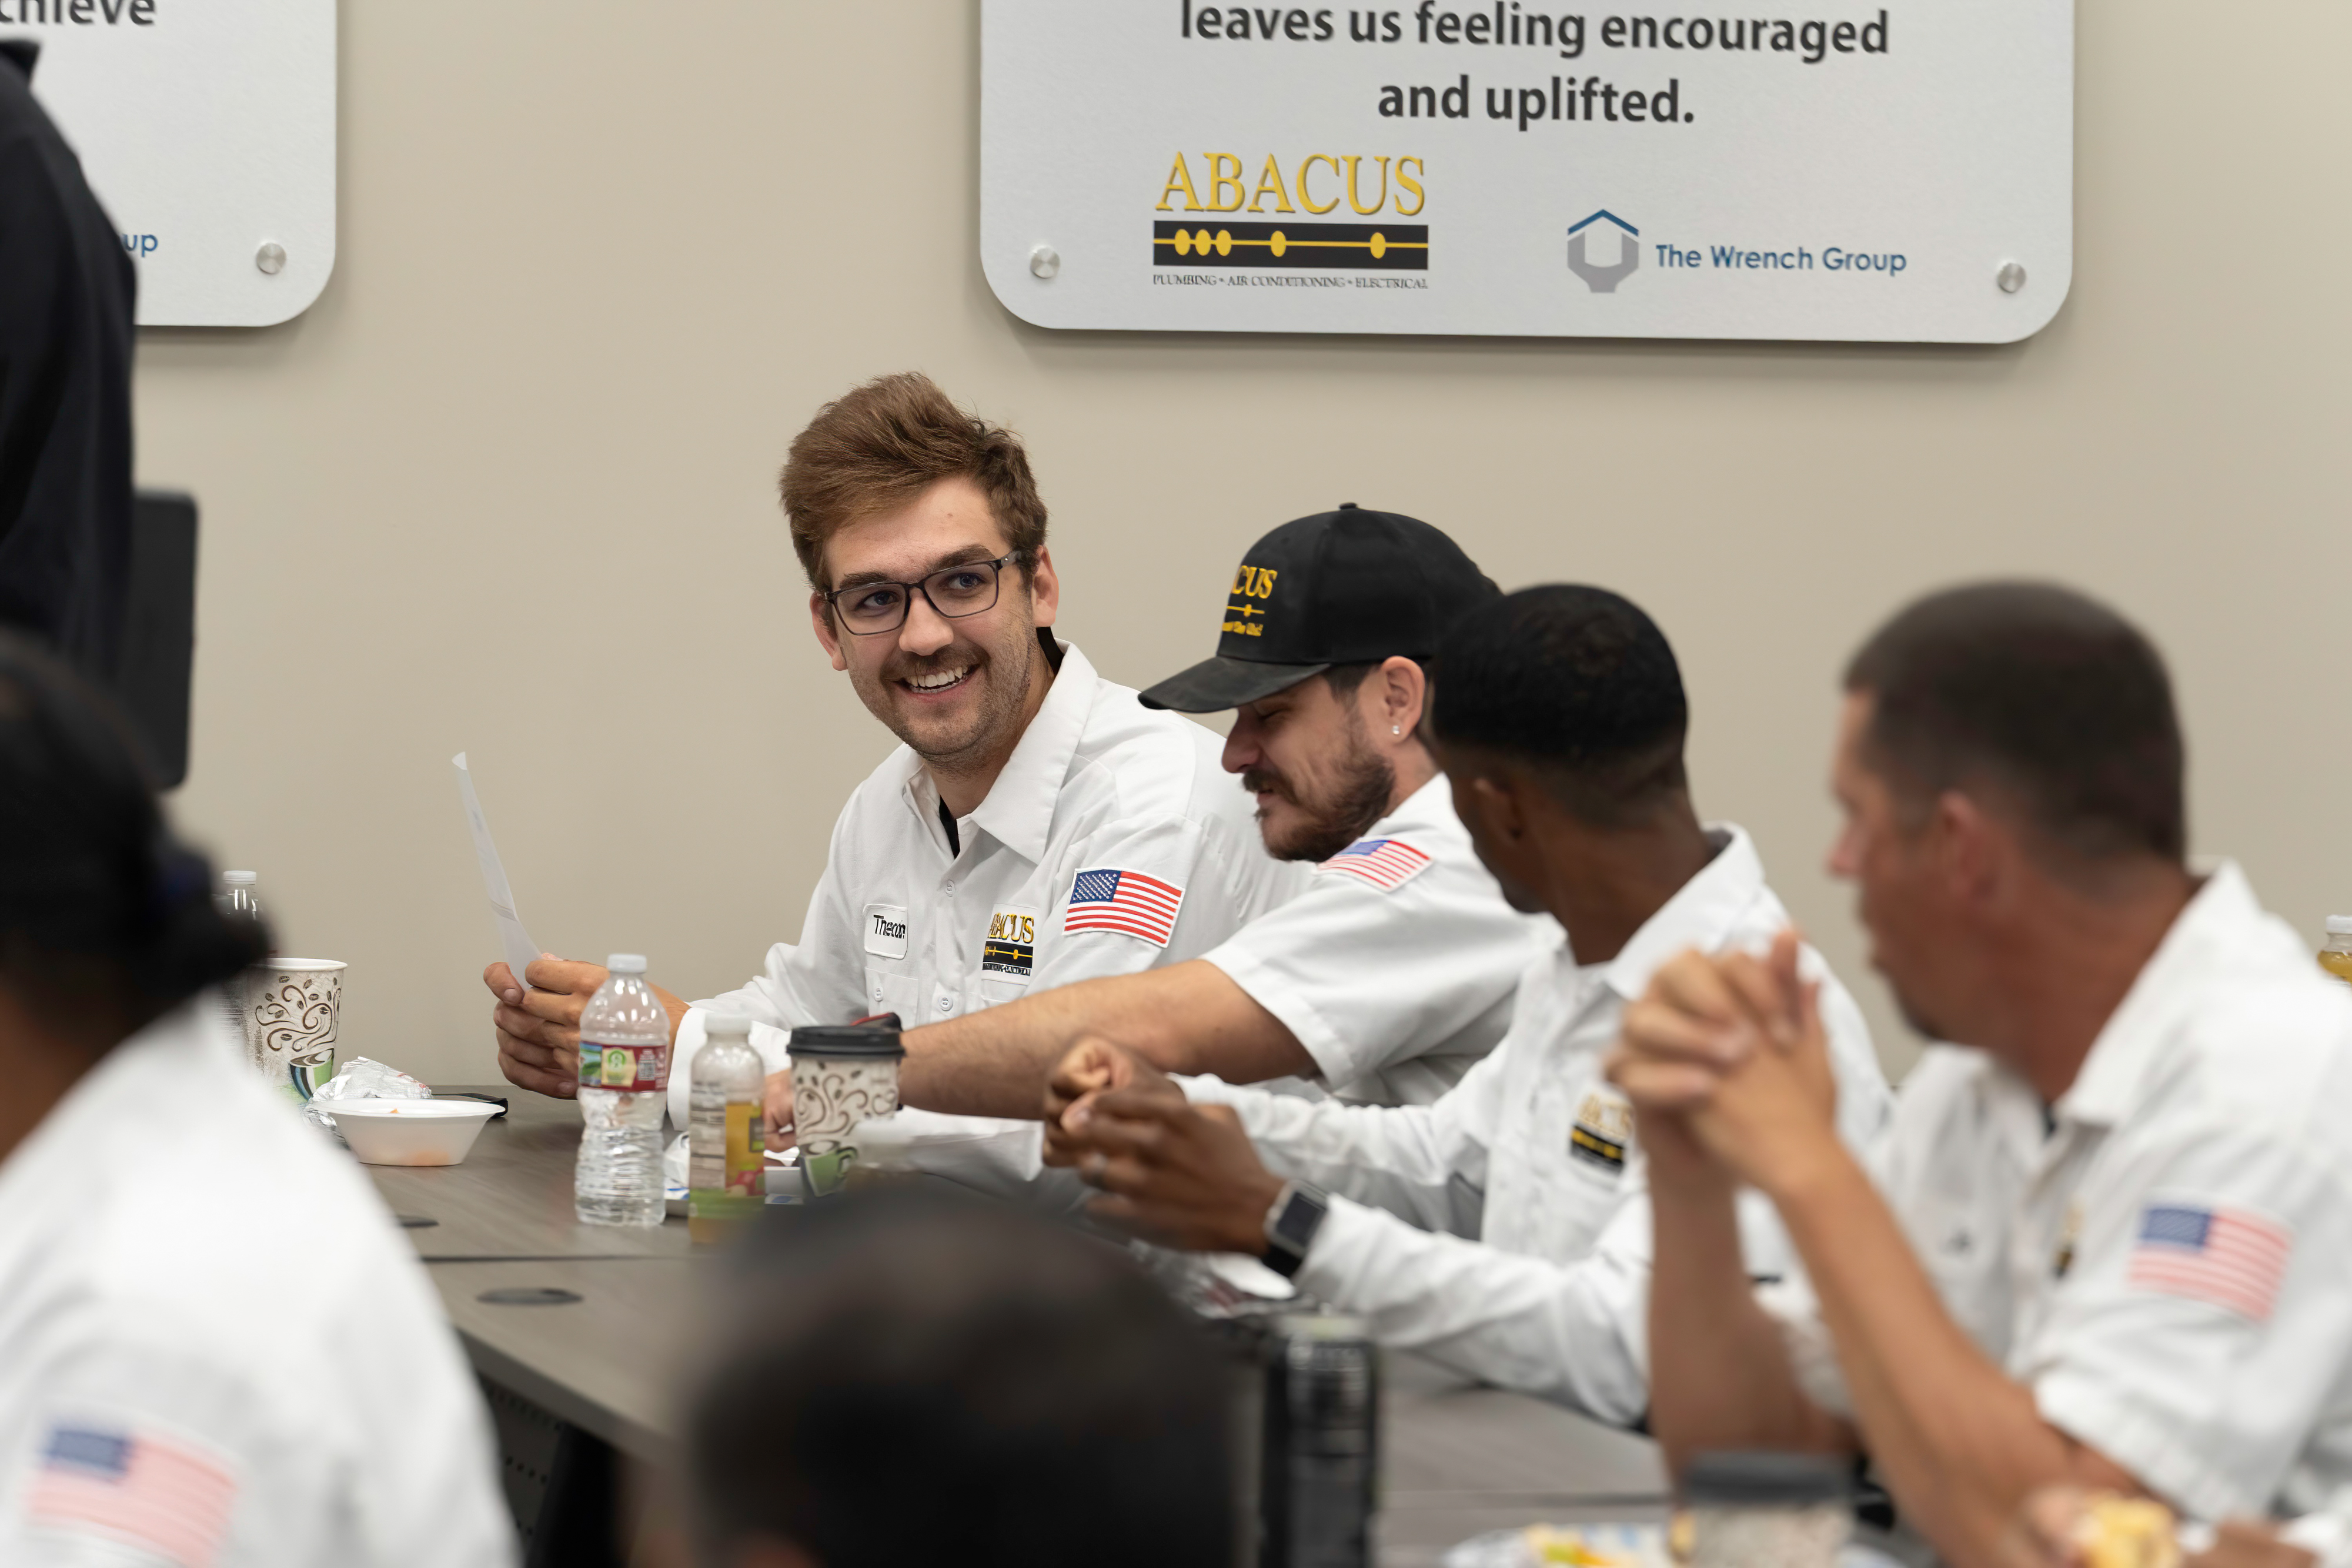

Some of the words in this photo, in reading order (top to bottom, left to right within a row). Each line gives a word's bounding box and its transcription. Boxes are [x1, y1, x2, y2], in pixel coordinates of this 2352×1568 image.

[0, 0, 156, 26] hieve
[1181, 0, 1334, 42] leaves
[1349, 11, 1402, 44] us
[1414, 0, 1585, 59] feeling
[1601, 9, 1888, 64] encouraged
[1378, 73, 1469, 119] and
[1486, 76, 1694, 132] uplifted.
[1154, 151, 1425, 216] ABACUS
[1152, 274, 1217, 286] PLUMBING
[1227, 275, 1249, 286] AIR
[1251, 276, 1346, 288] CONDITIONING
[1355, 277, 1429, 289] ELECTRICAL
[1655, 244, 1702, 268] The
[1710, 246, 1813, 270] Wrench
[1822, 248, 1907, 275] Group
